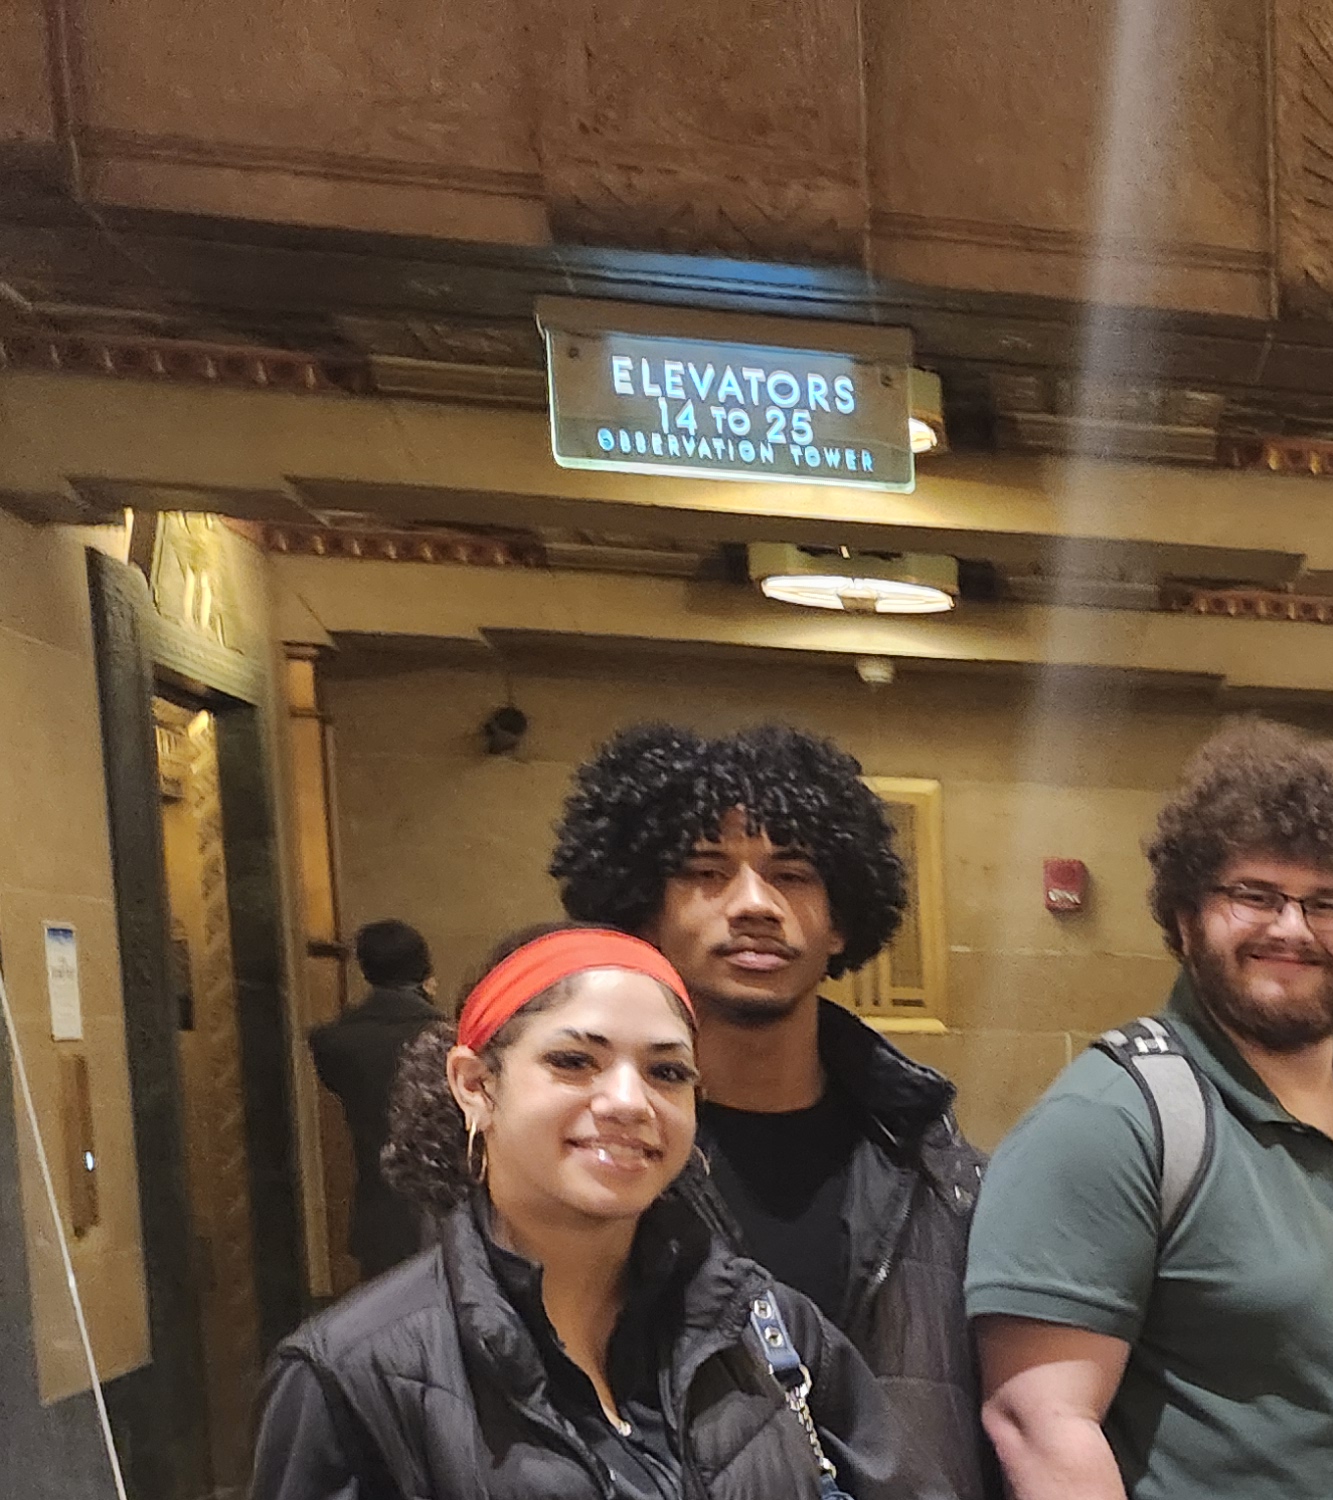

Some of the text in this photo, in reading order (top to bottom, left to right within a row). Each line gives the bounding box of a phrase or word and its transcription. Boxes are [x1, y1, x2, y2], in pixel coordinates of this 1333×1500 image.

[611, 355, 855, 414] ELEVATORS
[658, 396, 814, 446] 14 TO 25
[597, 427, 874, 473] OBSERVATION TOWER
